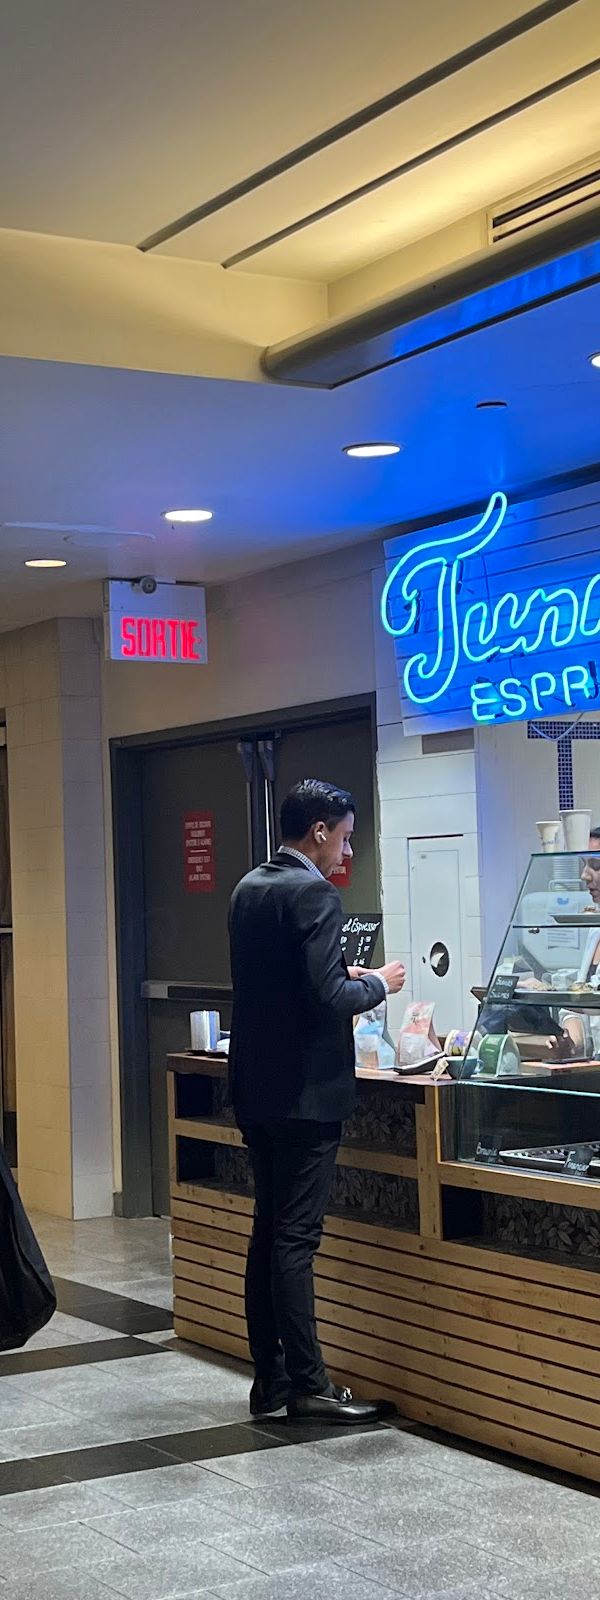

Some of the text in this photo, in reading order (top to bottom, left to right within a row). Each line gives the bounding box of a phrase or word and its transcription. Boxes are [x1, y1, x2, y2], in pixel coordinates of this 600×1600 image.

[121, 616, 202, 660] SORTIE
[470, 665, 593, 721] ESPR
[350, 918, 380, 935] Espresso
